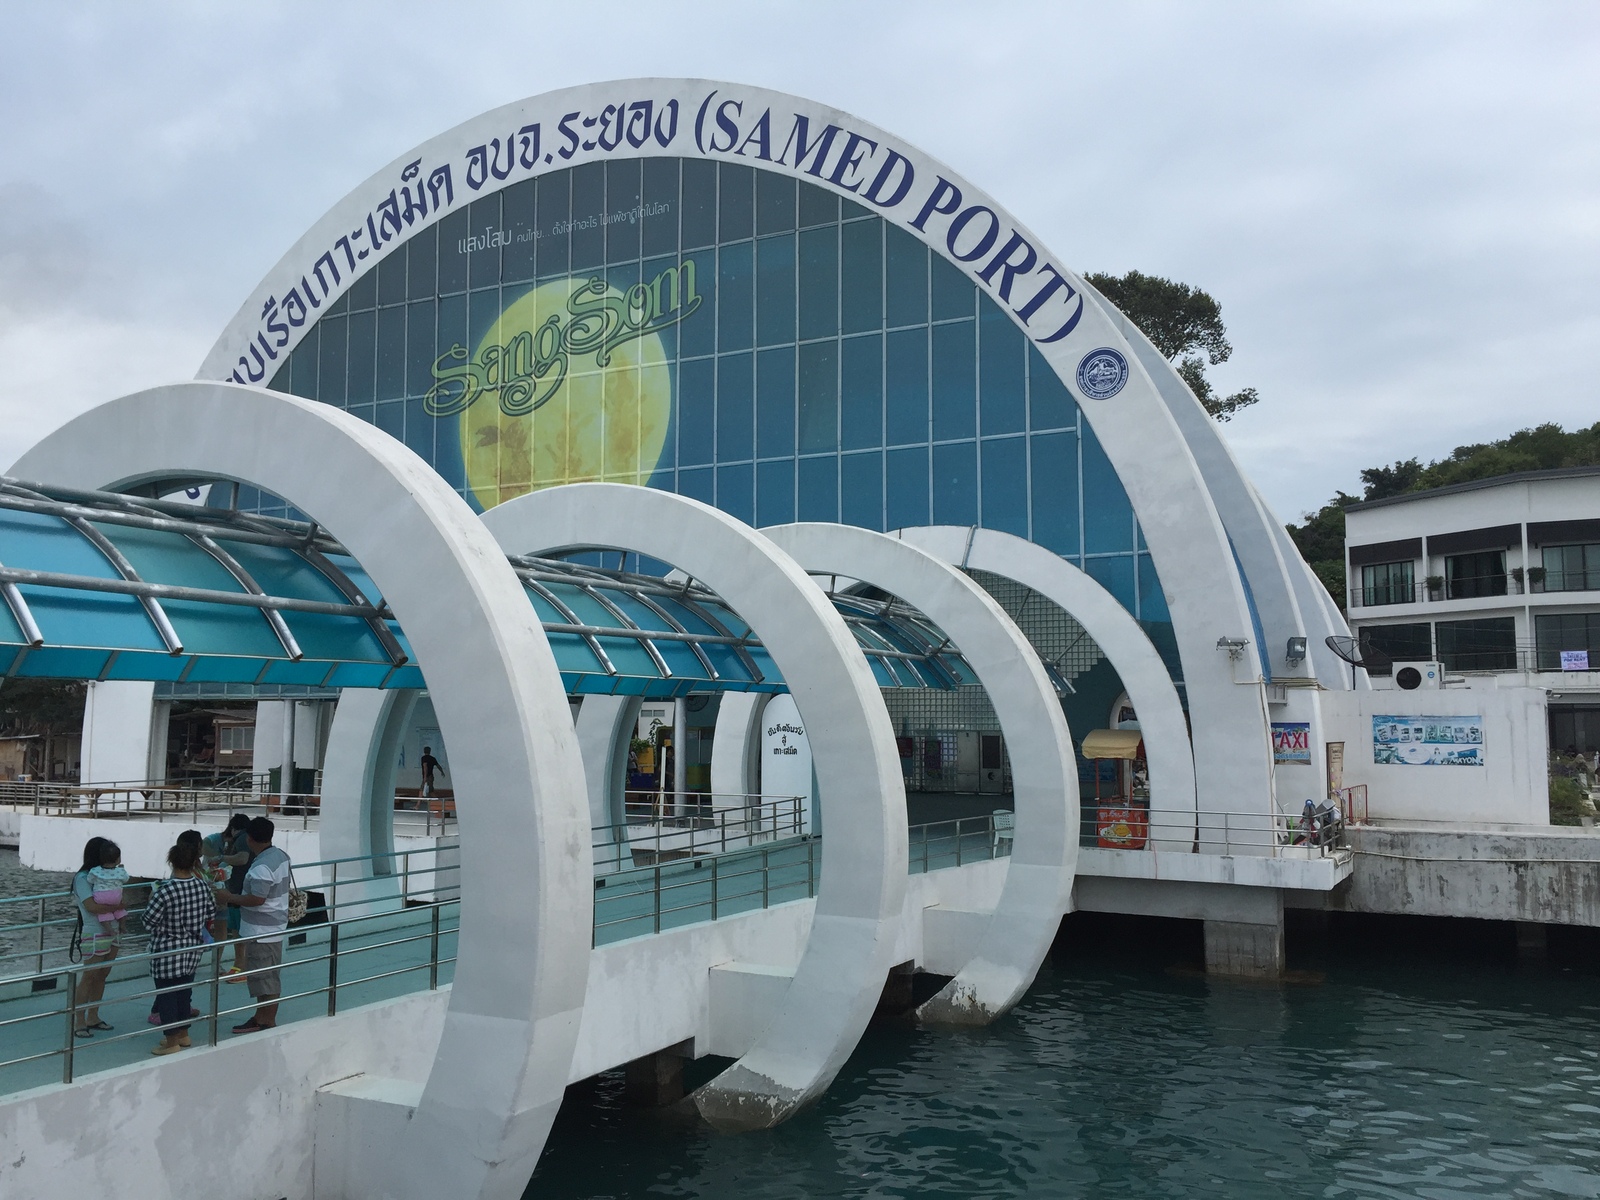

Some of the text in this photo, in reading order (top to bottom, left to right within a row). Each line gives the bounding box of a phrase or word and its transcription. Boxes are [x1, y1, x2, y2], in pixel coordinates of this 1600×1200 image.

[694, 90, 1084, 343] (SAMED PORT)
[458, 226, 512, 254] แสงโสม
[226, 157, 454, 385] บเรือเกาะเสม็ด
[773, 745, 798, 755] เกาะเสม็ด
[1271, 732, 1308, 748] TAXI
